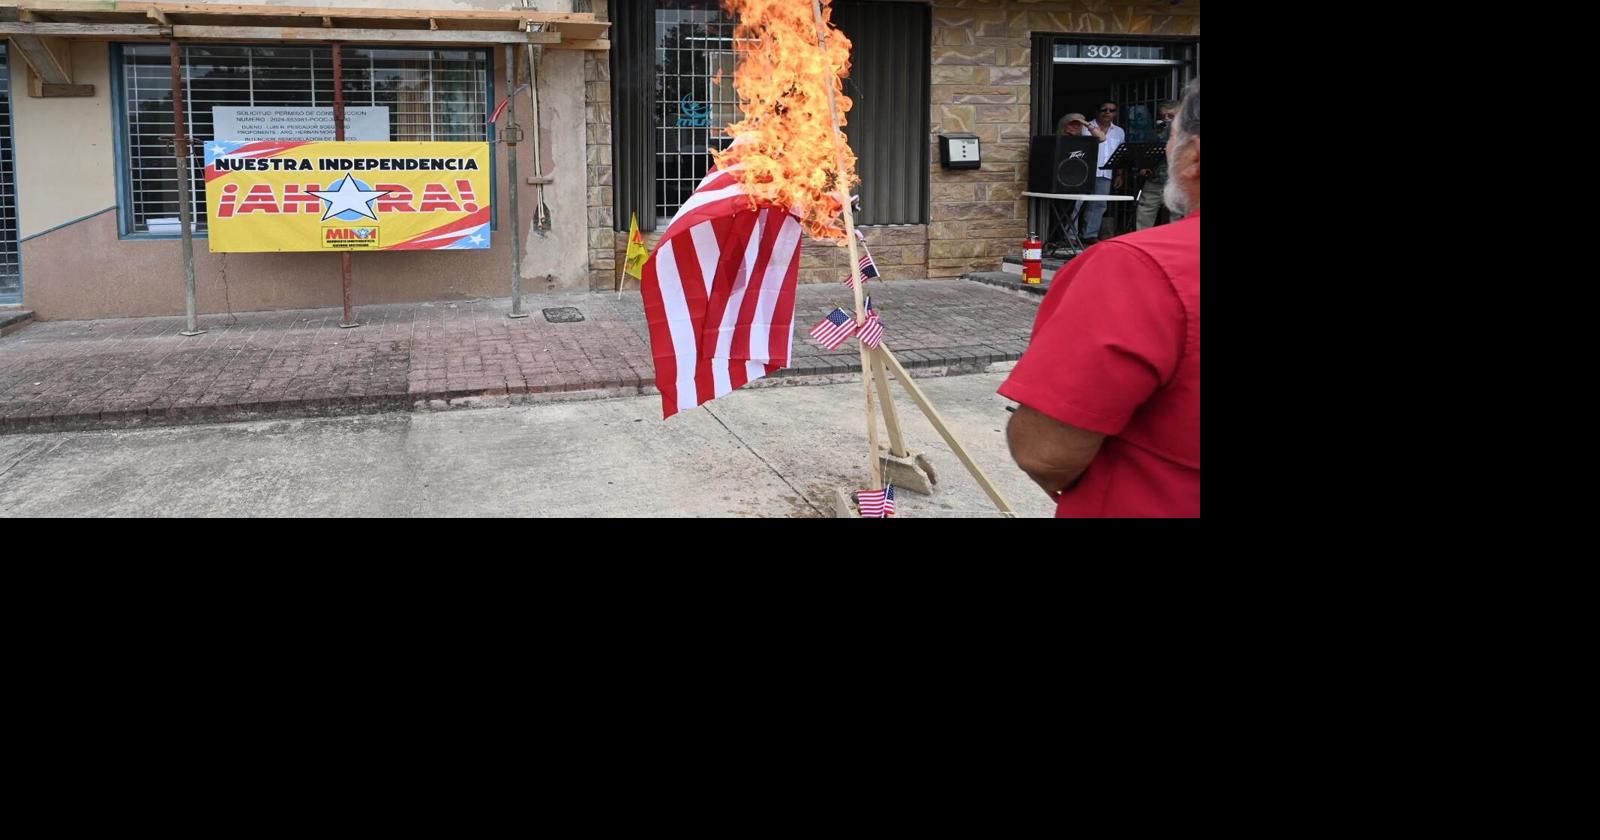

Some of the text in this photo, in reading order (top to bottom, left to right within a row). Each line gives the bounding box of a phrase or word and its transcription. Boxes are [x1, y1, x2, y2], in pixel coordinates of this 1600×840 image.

[1087, 45, 1122, 58] 302
[214, 157, 479, 171] NUESTRA INDEPENDENCIA
